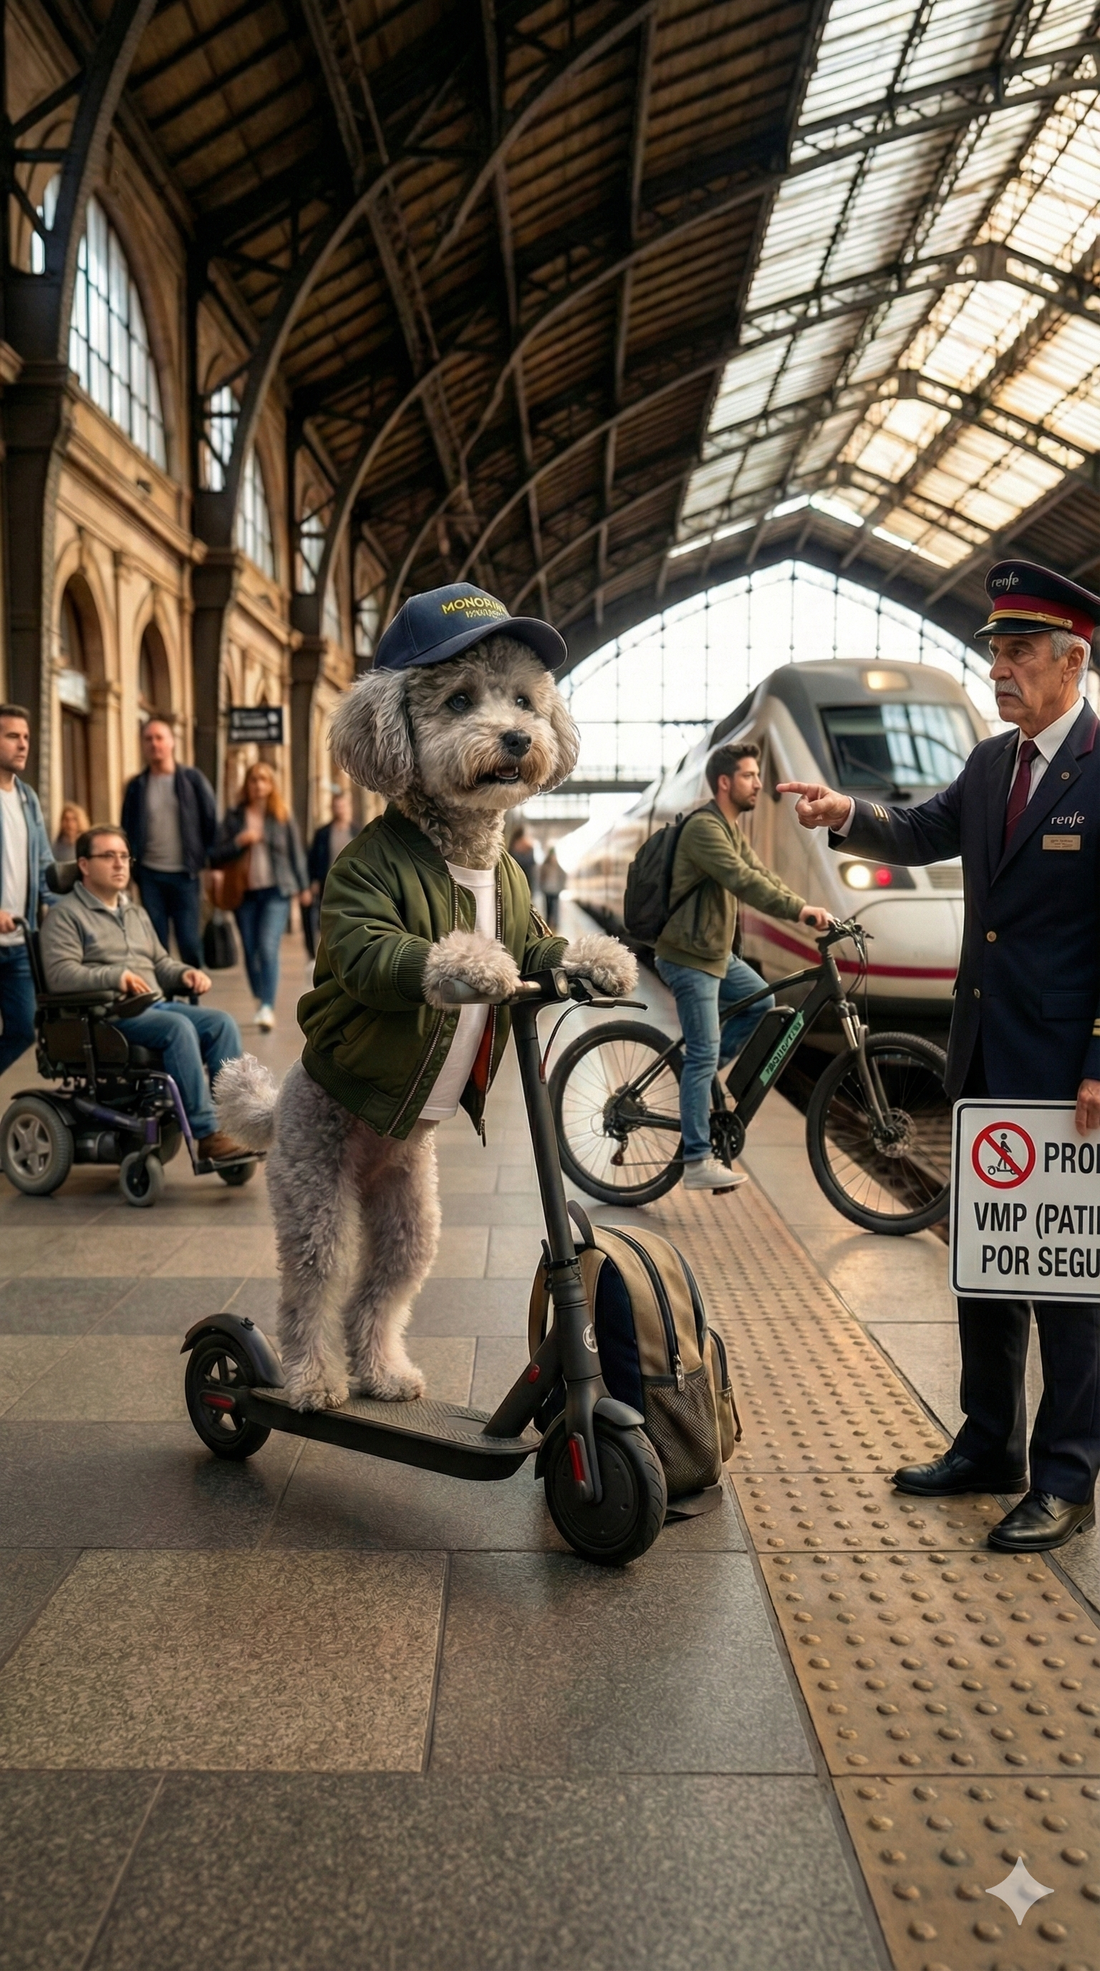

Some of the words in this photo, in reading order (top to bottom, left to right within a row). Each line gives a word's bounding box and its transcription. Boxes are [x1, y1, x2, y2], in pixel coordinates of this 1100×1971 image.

[991, 571, 1019, 591] renfe
[1051, 811, 1085, 828] renfe
[1044, 1142, 1100, 1174] PRO
[974, 1202, 1028, 1232] VMP
[1036, 1202, 1100, 1240] (PATI
[981, 1244, 1030, 1275] POR
[1038, 1246, 1100, 1278] SEGU
